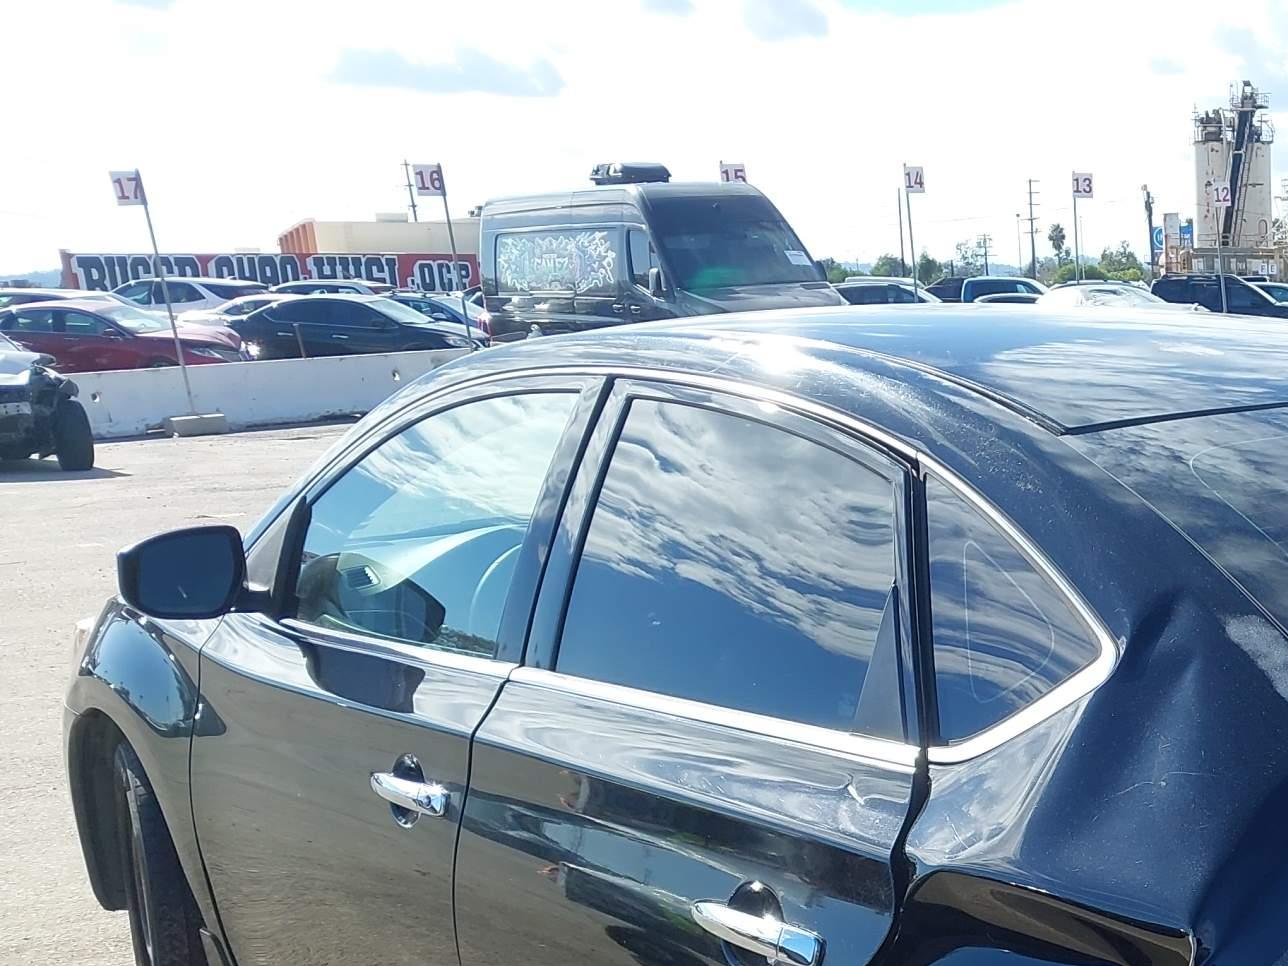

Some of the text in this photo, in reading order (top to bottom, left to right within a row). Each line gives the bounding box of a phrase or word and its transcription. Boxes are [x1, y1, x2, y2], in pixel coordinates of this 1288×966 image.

[415, 170, 442, 191] 16
[721, 168, 746, 183] 15
[905, 171, 924, 189] 14
[113, 177, 139, 200] 17
[1073, 177, 1092, 194] 13
[1213, 186, 1230, 203] 12
